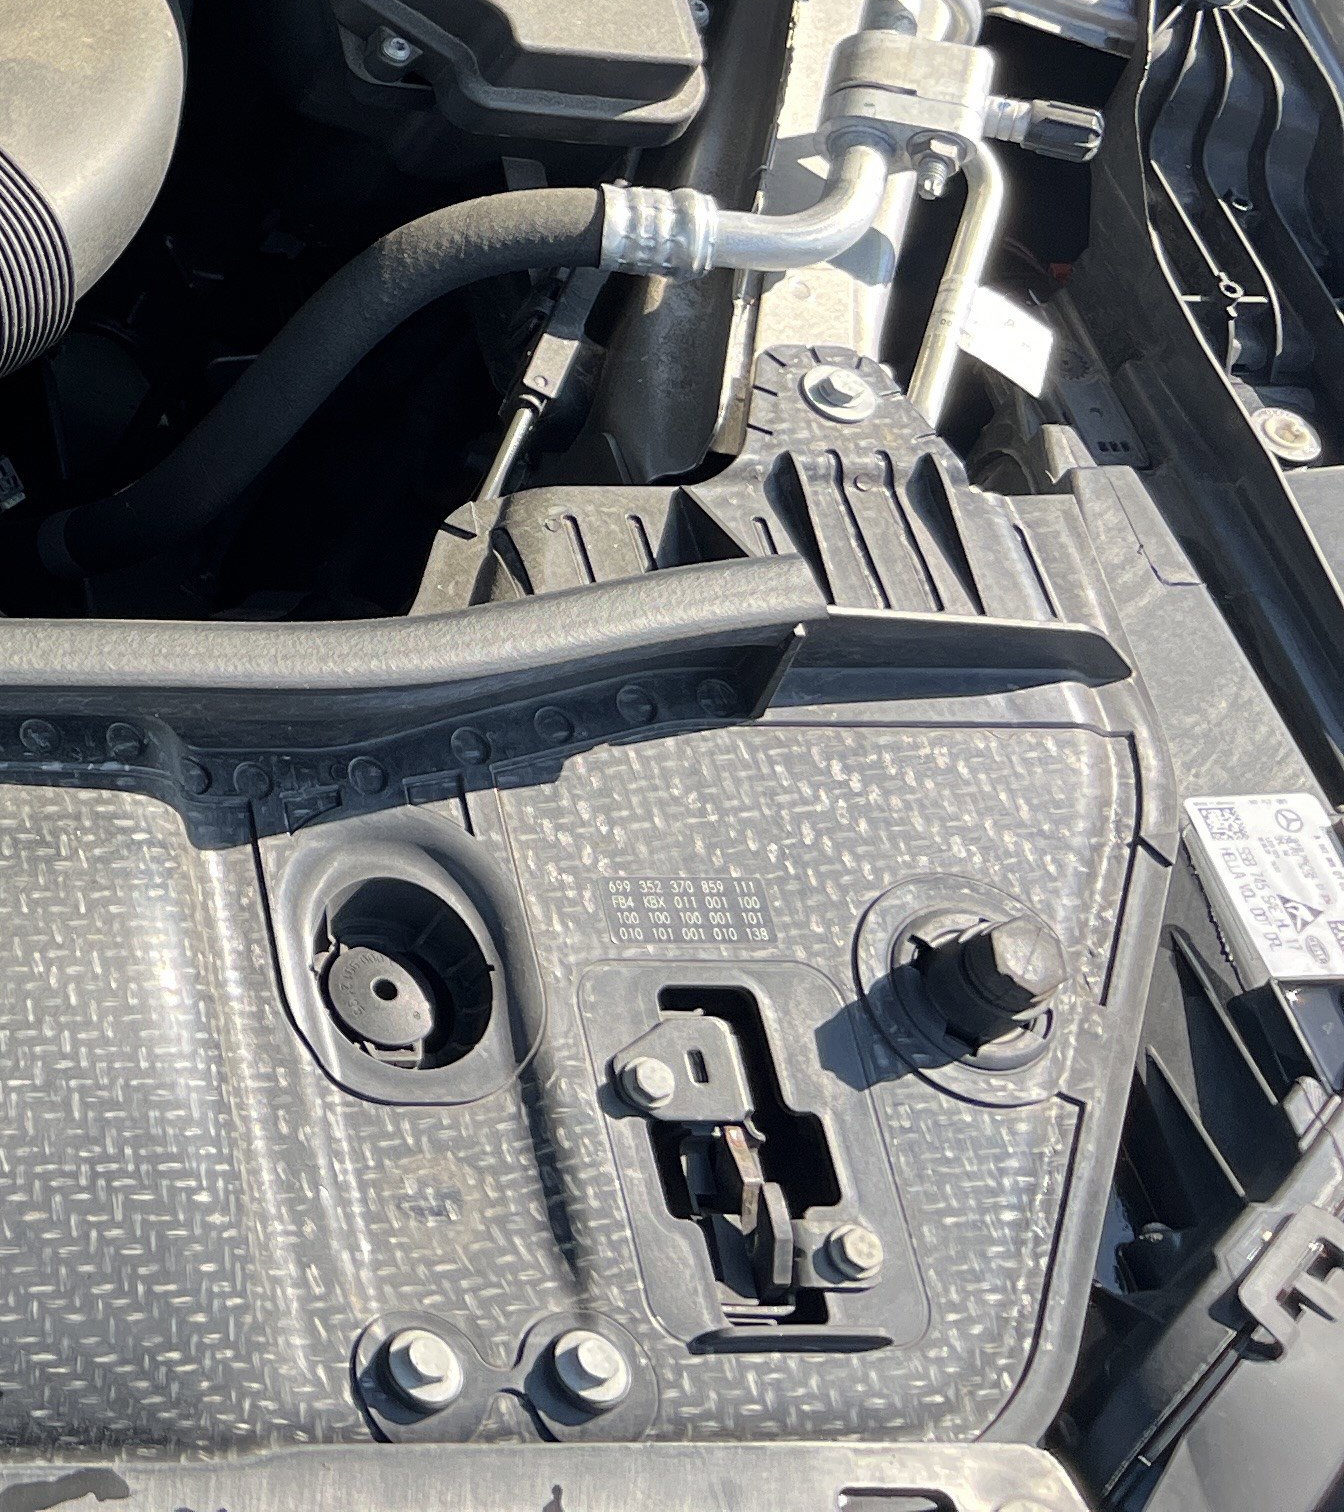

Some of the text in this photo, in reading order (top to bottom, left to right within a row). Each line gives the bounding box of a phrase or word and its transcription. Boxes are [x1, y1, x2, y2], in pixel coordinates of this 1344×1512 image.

[609, 880, 755, 893] 699 352 370 859 111
[612, 896, 760, 909] FB4 KBX 011 001 100
[617, 912, 764, 925] 100 100 100 001 101
[620, 928, 769, 941] 010 101 001 010 138
